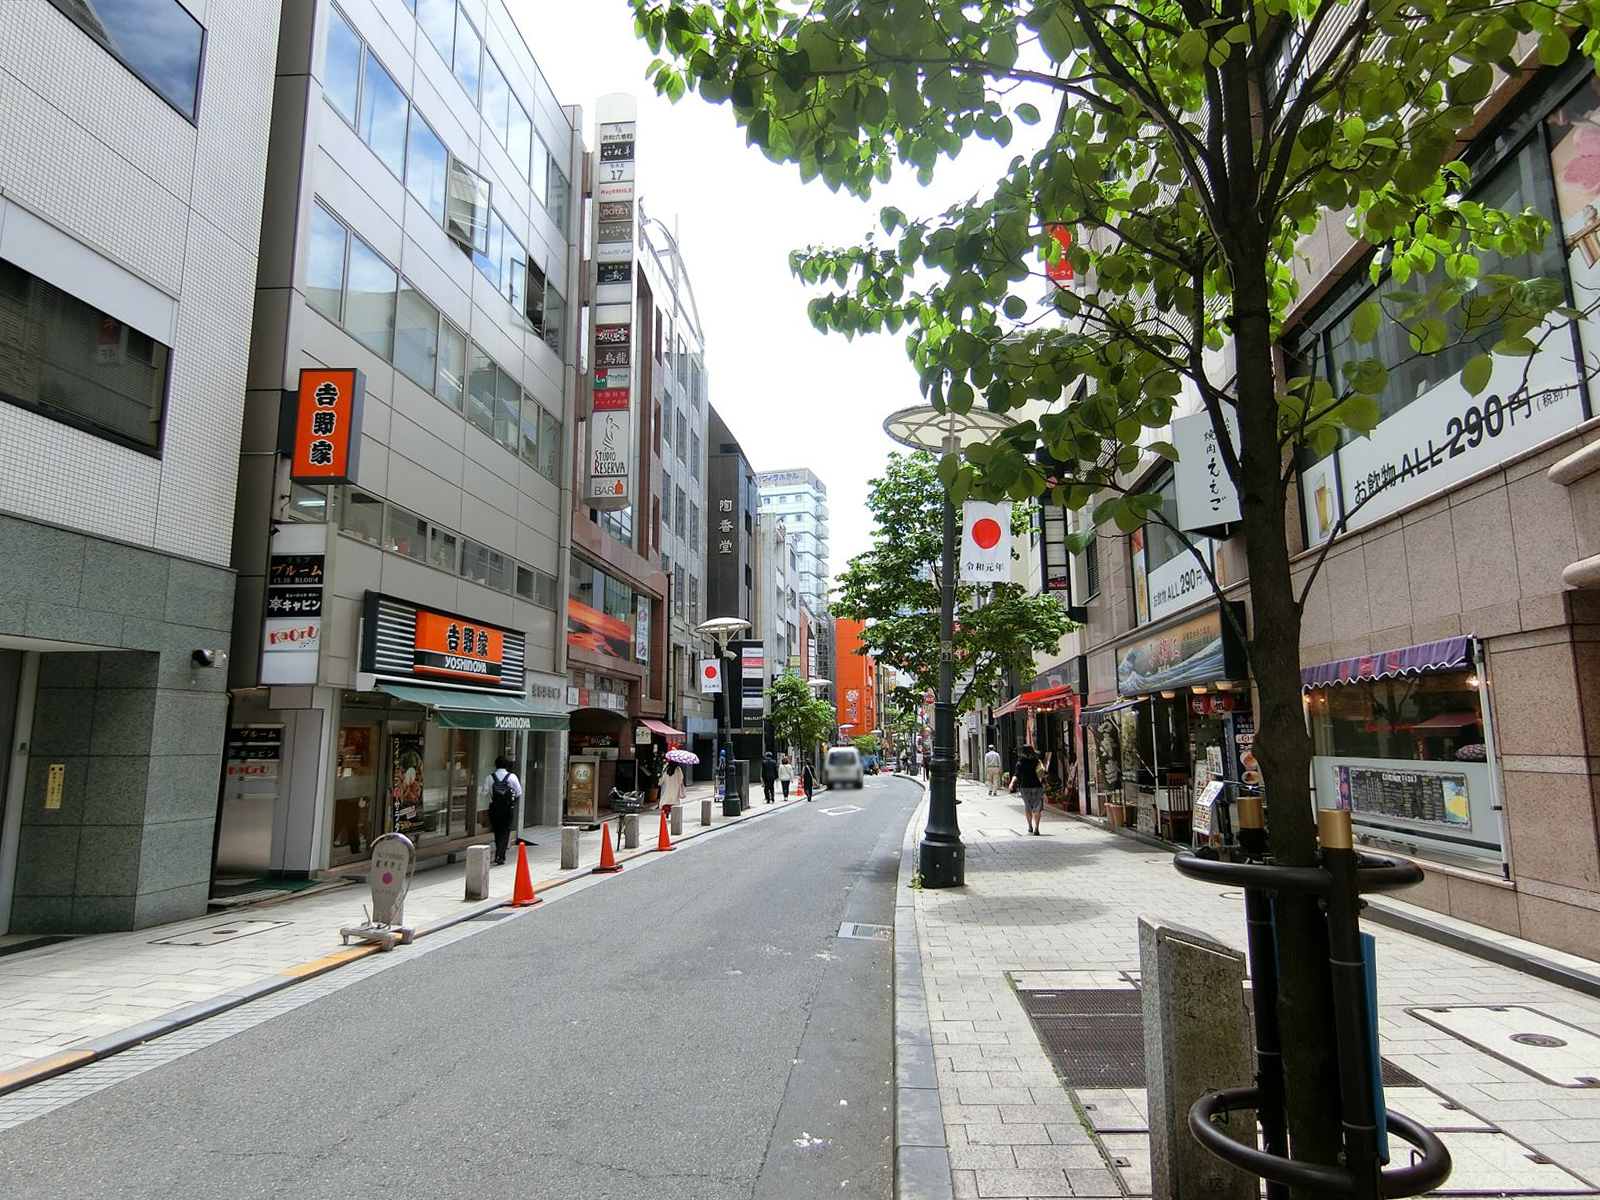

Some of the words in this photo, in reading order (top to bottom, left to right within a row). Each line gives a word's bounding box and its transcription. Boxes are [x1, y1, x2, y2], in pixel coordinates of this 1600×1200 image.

[611, 170, 624, 180] 17
[309, 381, 340, 466] 吉野家
[594, 449, 616, 461] STUDIO
[594, 460, 626, 474] RESERVA
[595, 486, 615, 496] BAR
[718, 499, 734, 554] 陶香堂
[271, 563, 323, 576] ブルーム
[966, 561, 1004, 571] 令和元年
[446, 623, 488, 658] 吉野家
[445, 656, 487, 673] YOSHINOYA
[495, 716, 531, 729] YOSHINOYA
